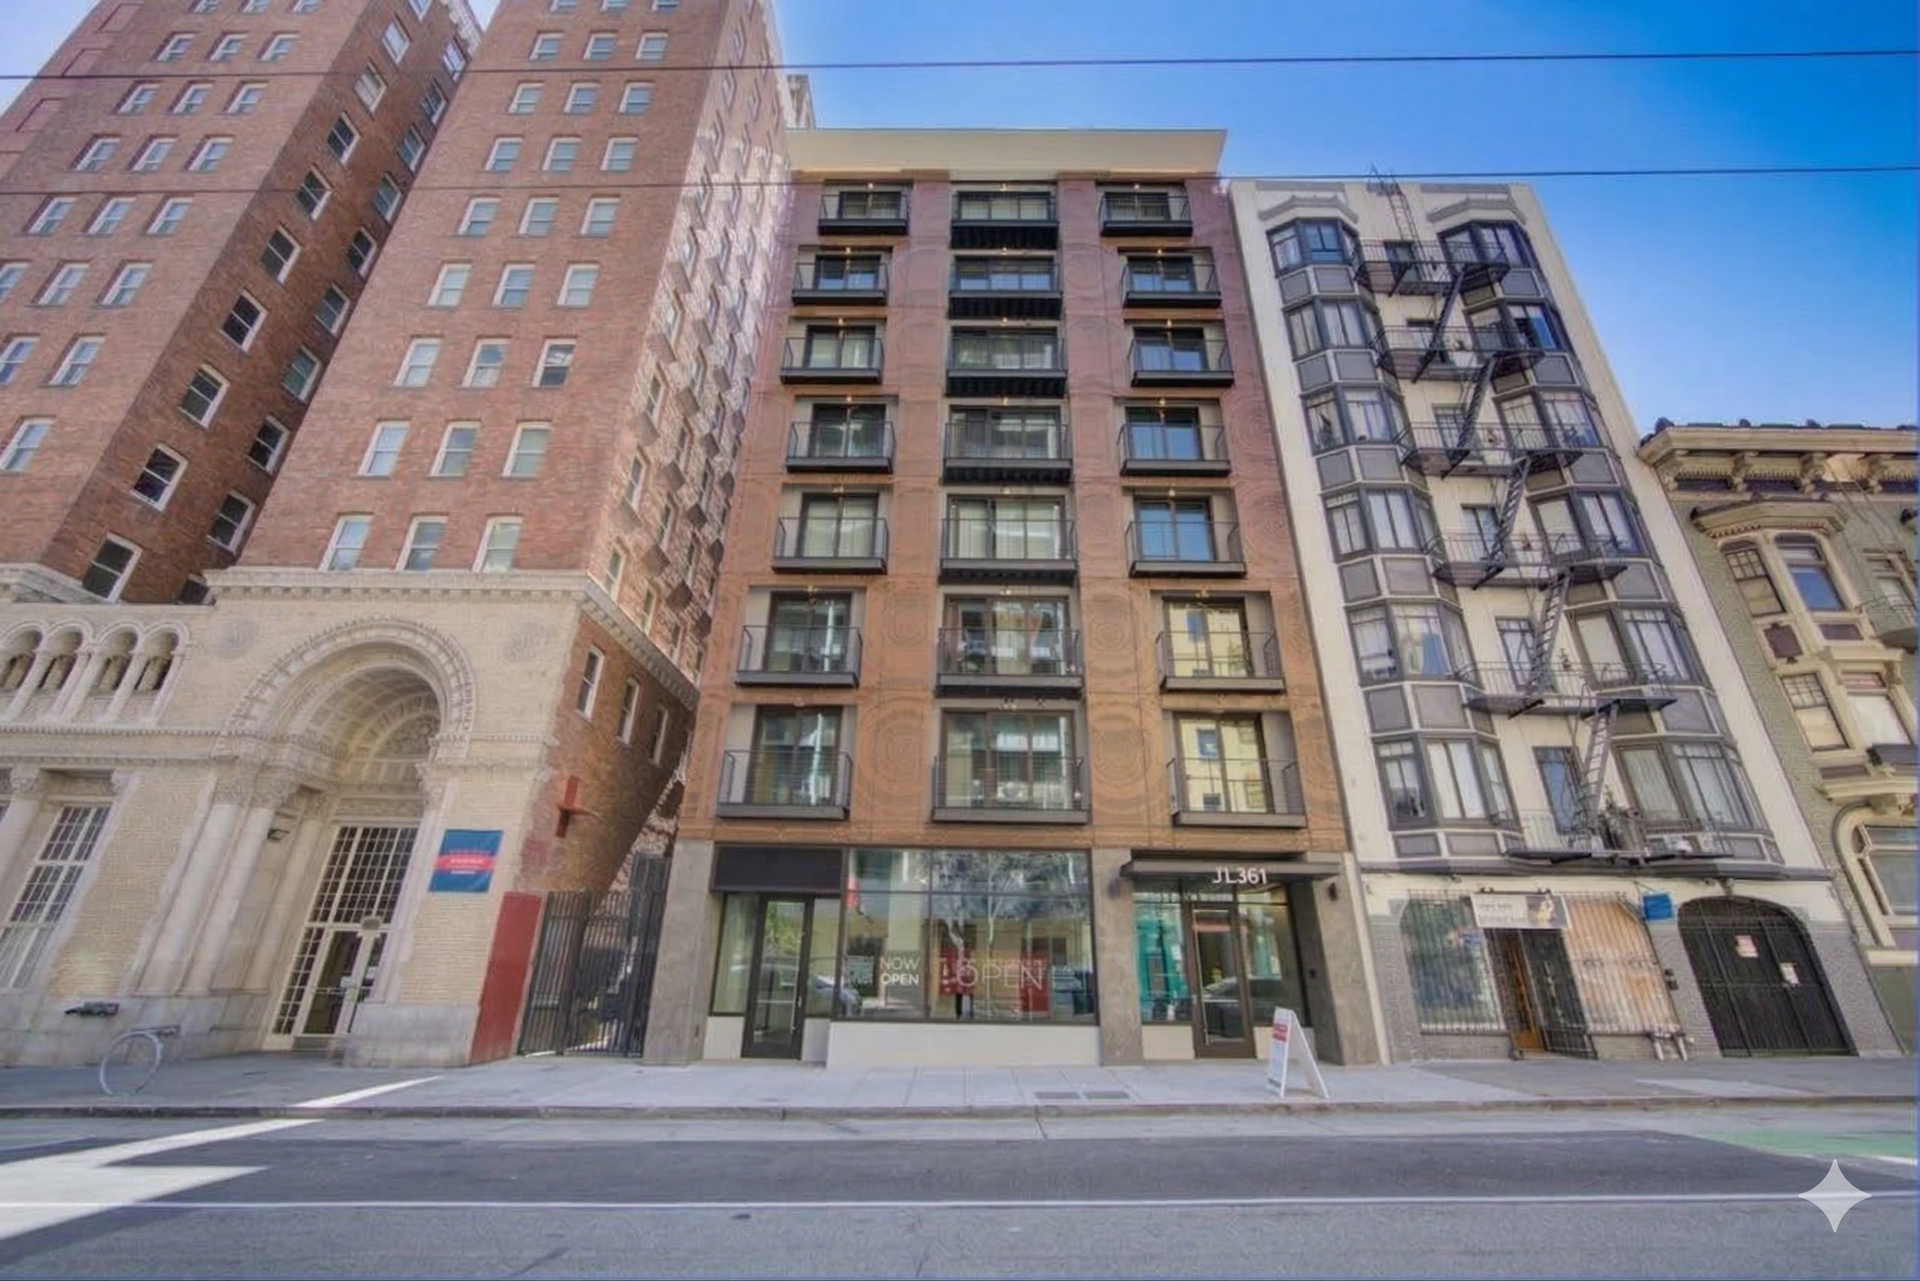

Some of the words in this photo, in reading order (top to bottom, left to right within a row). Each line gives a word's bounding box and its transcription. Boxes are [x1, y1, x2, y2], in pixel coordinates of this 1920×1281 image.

[1212, 866, 1267, 885] JL361
[880, 956, 921, 970] NOW
[880, 972, 919, 986] OPEN
[957, 963, 1043, 990] OPEN
